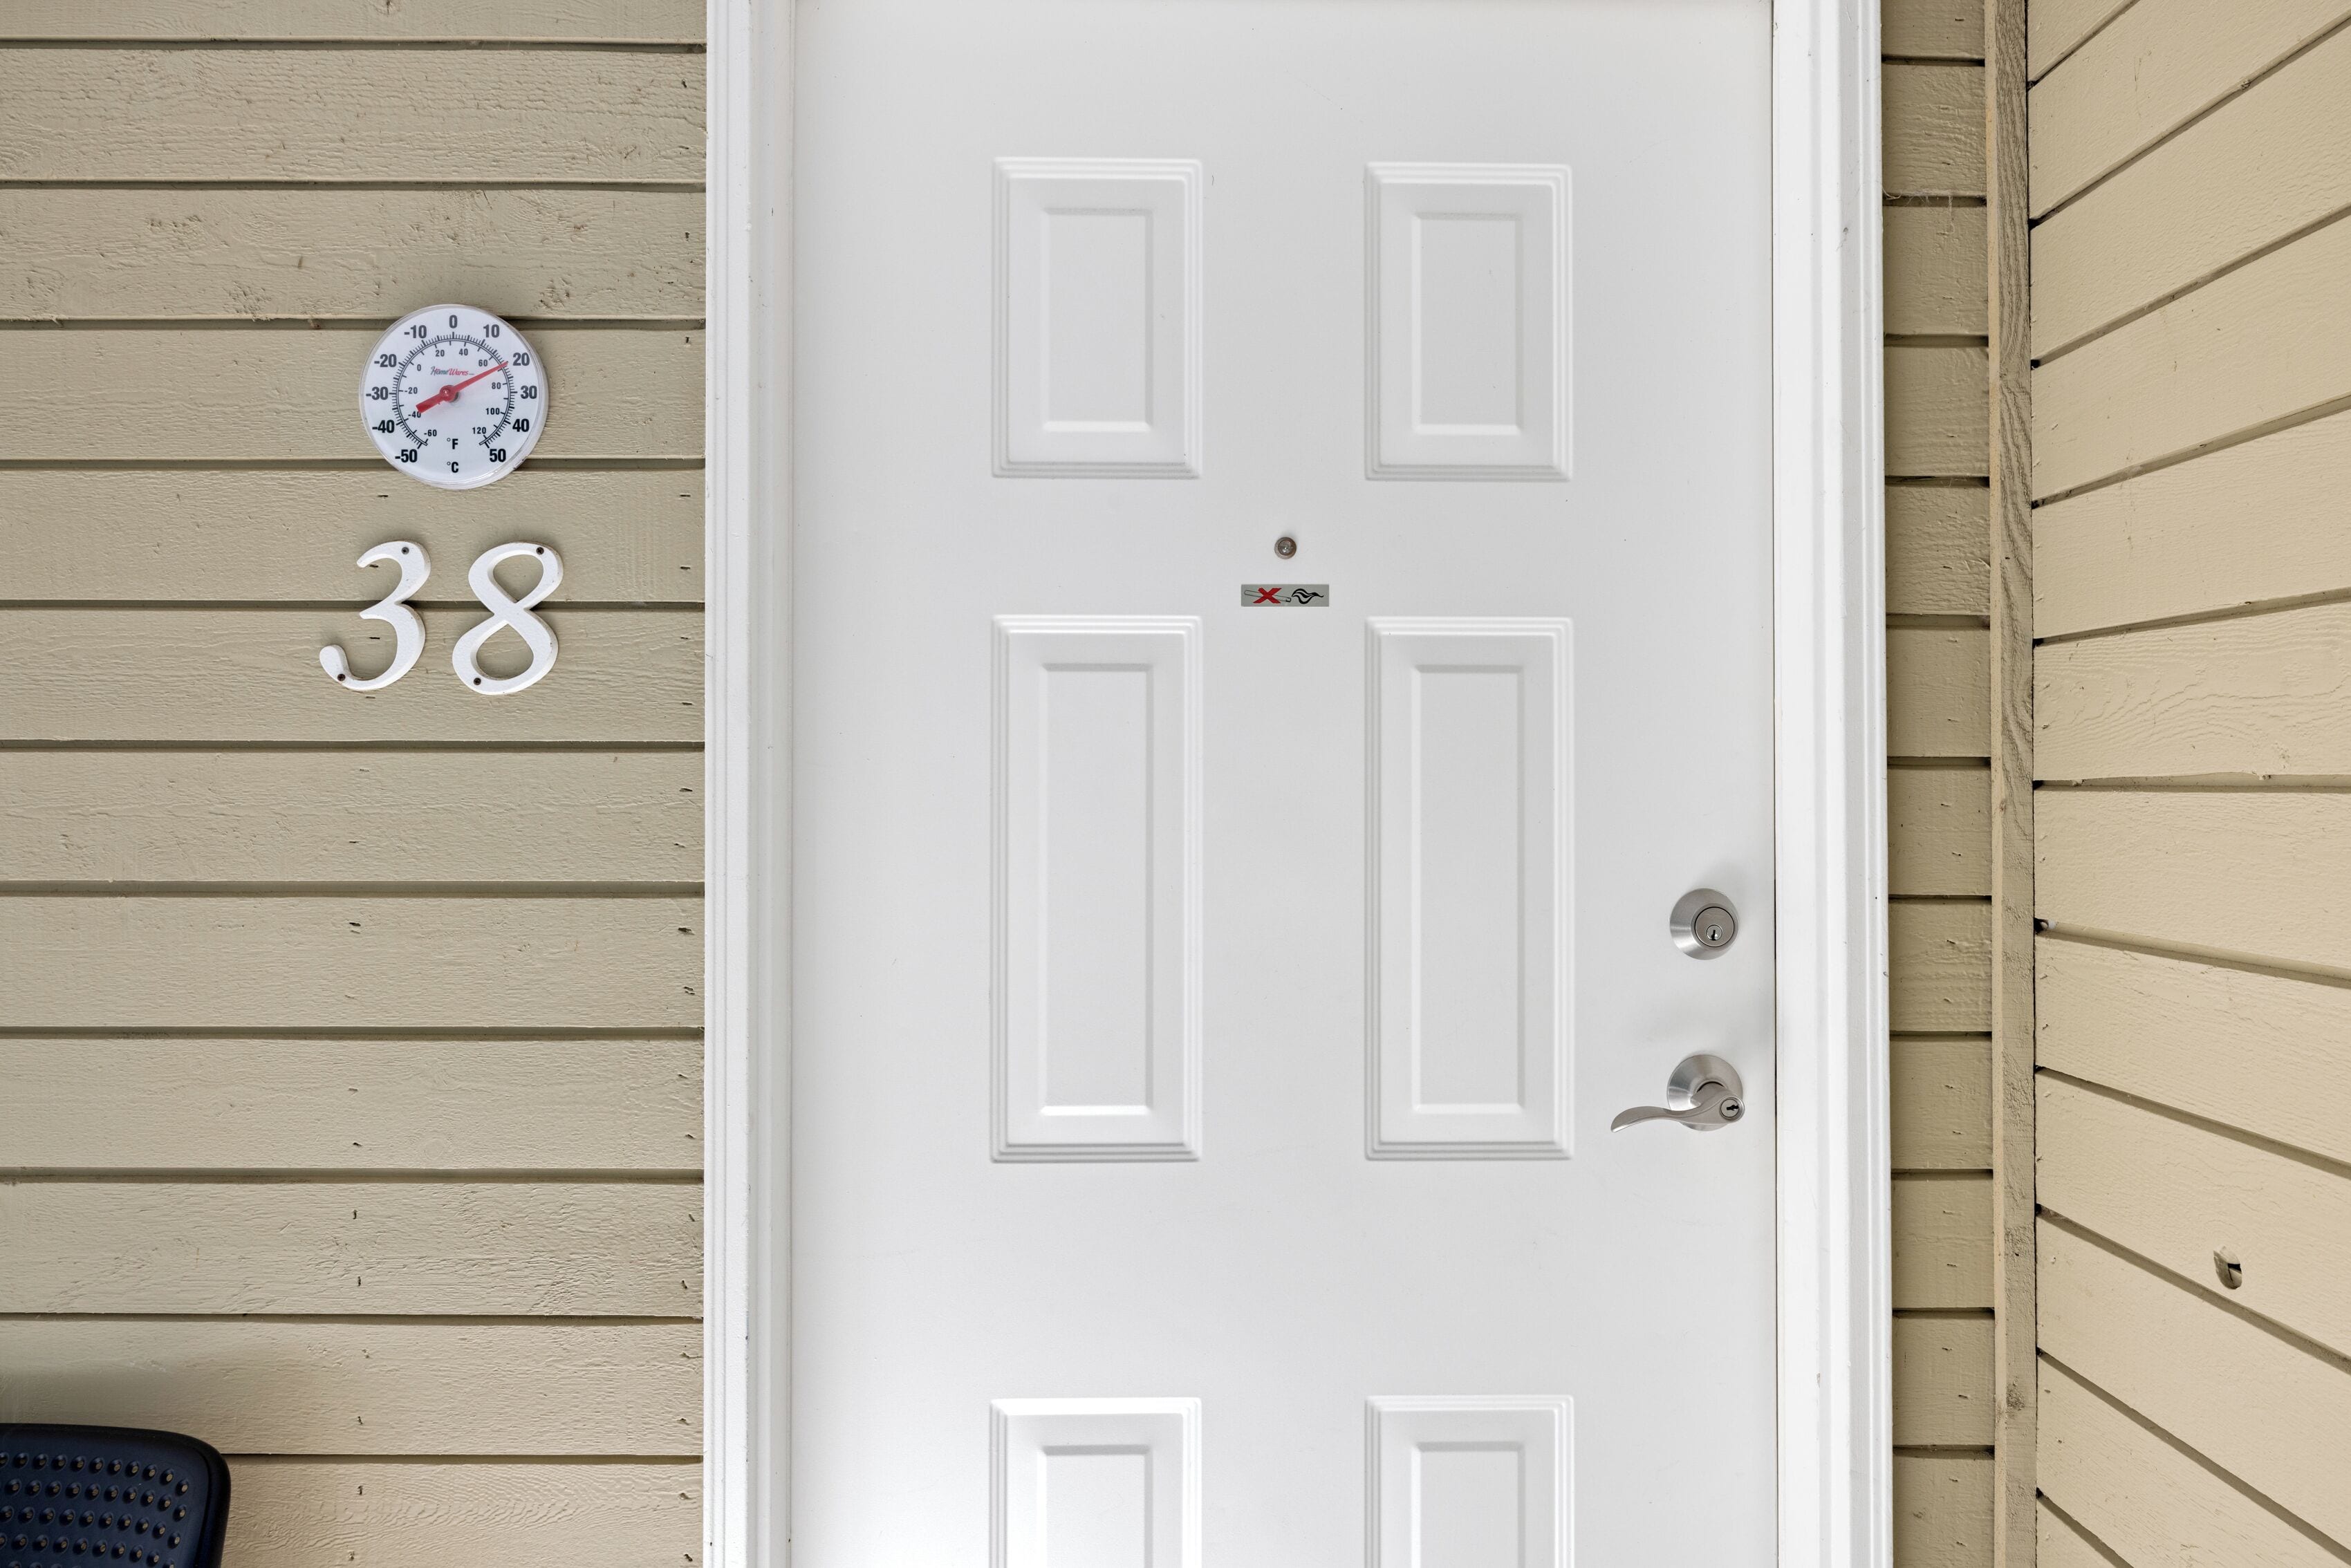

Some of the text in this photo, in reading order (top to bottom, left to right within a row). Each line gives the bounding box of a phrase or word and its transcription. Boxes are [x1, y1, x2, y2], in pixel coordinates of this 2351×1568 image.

[449, 315, 457, 328] 0
[404, 325, 427, 339] -10
[483, 324, 499, 338] 10
[459, 348, 468, 356] 40
[374, 354, 397, 368] -20
[513, 353, 530, 366] 20
[366, 386, 389, 400] -30
[521, 386, 537, 399] 30
[372, 420, 394, 433] -40
[512, 419, 529, 432] 40
[395, 449, 418, 463] -50
[490, 449, 506, 462] 50
[319, 540, 564, 696] 38
